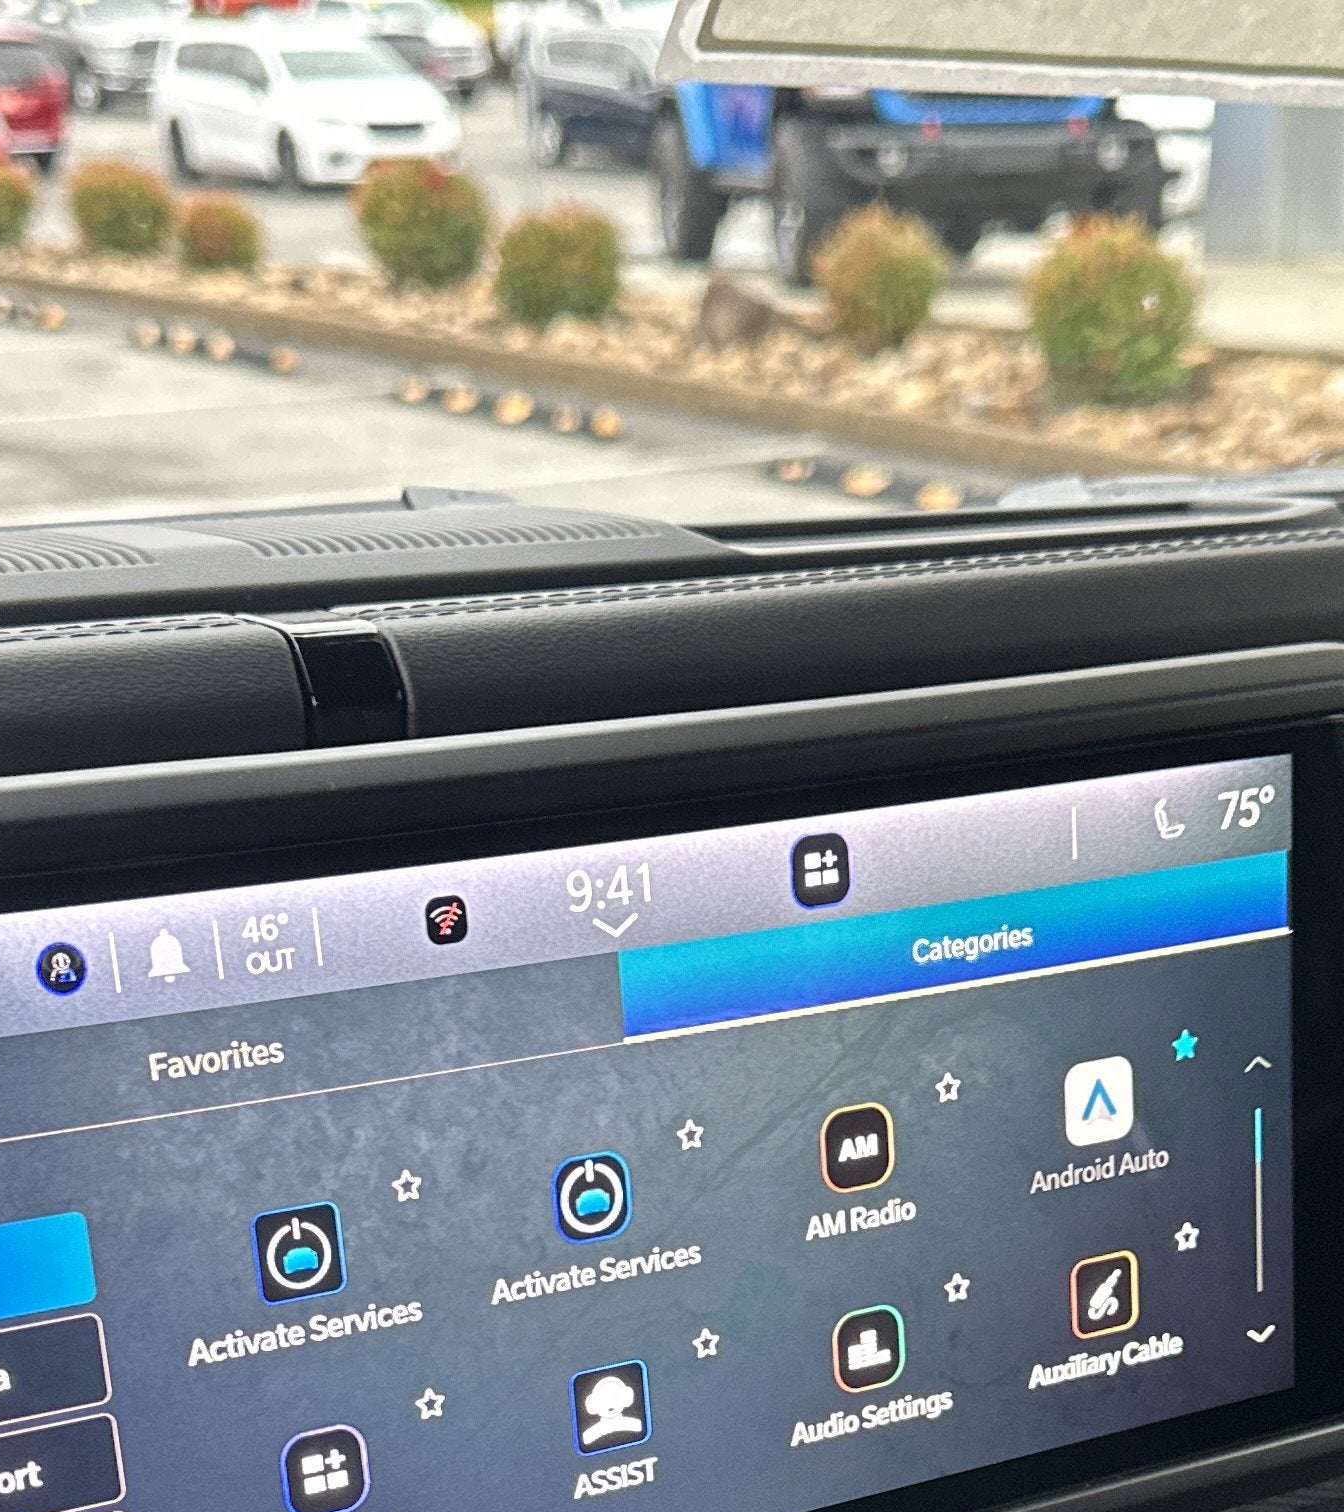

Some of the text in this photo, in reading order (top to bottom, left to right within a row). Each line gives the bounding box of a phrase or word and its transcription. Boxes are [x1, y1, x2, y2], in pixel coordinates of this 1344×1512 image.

[1217, 784, 1275, 832] 75°
[565, 862, 653, 914] 9:41
[241, 911, 289, 943] 46°
[911, 923, 1034, 965] Categories
[244, 946, 296, 976] OUT
[148, 1037, 286, 1083] Favorites
[837, 1132, 880, 1164] AM
[1029, 1147, 1170, 1195] Android Auto
[805, 1199, 917, 1242] AM Radio
[490, 1245, 703, 1306] Activate Services
[188, 1300, 425, 1368] Activate Services
[1121, 1332, 1185, 1364] Cable
[790, 1390, 955, 1448] Audio Settings
[574, 1457, 659, 1500] ASSIST
